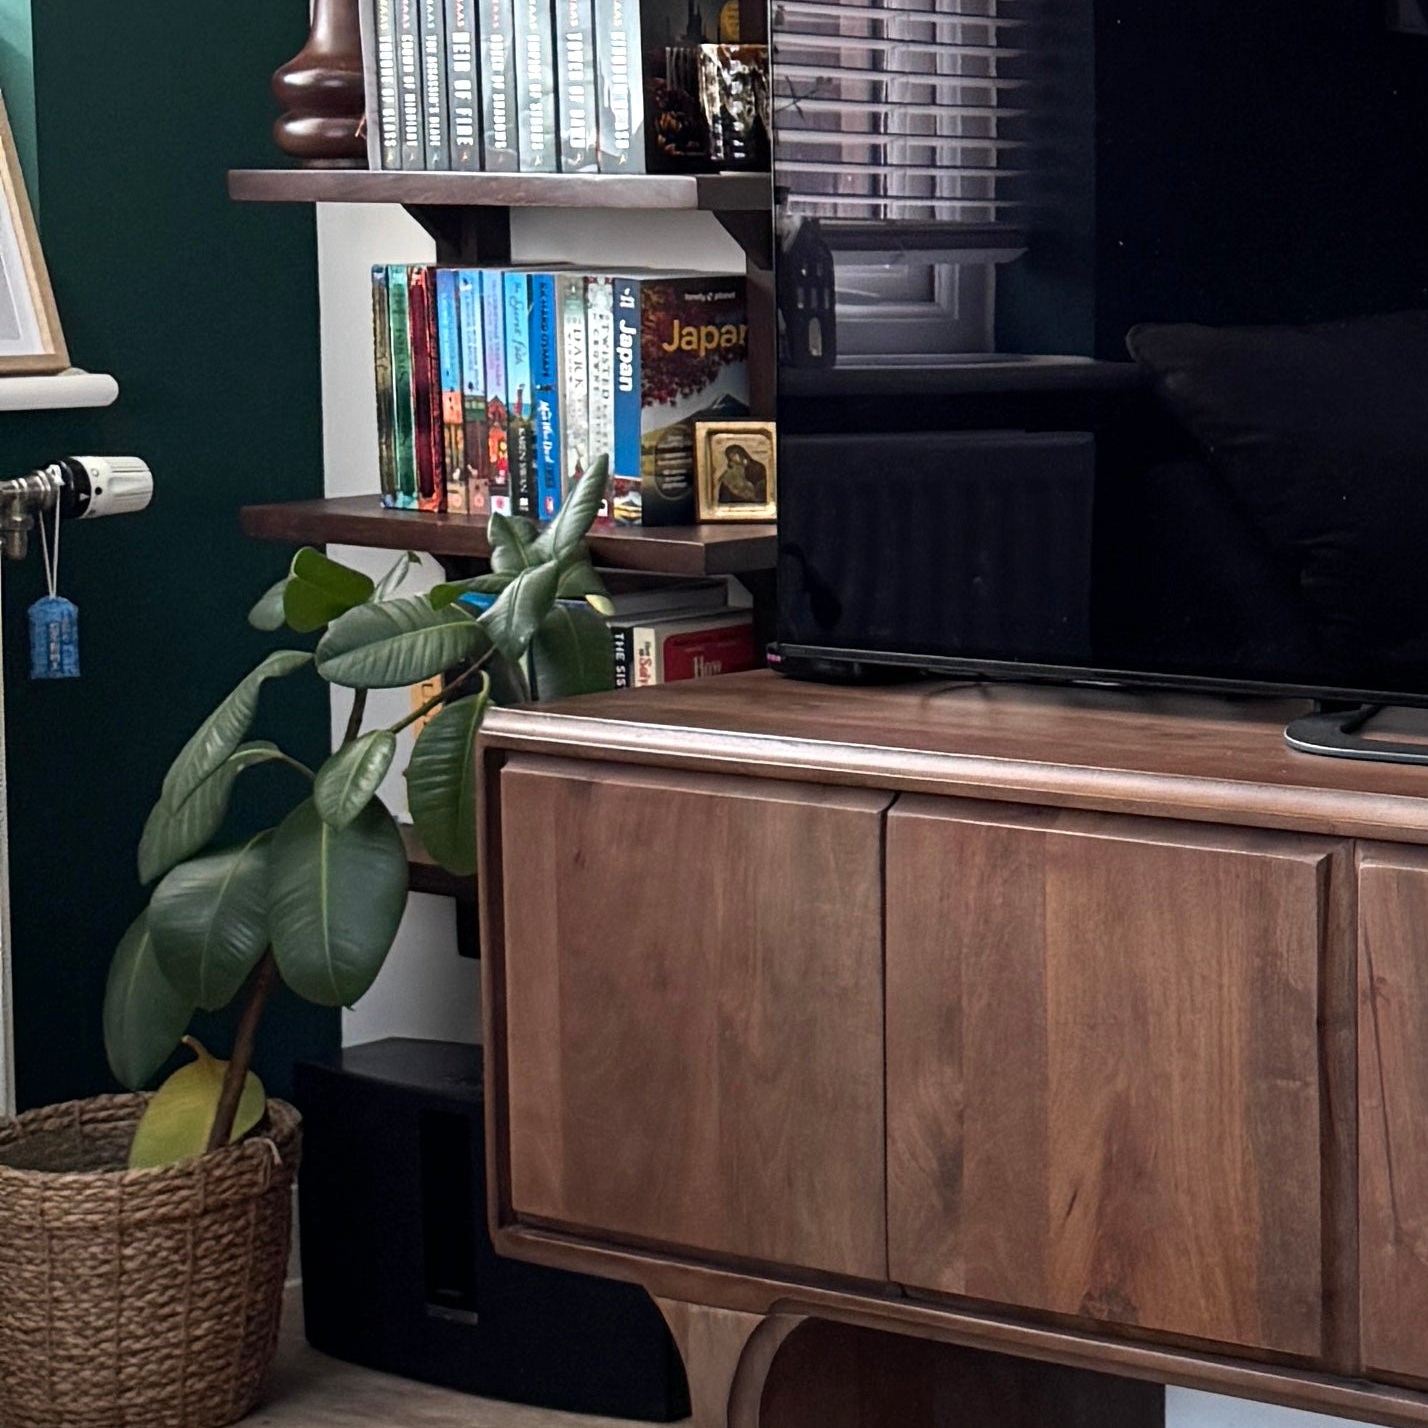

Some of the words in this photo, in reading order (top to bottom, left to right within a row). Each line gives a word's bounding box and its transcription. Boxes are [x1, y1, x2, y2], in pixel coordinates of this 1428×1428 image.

[451, 31, 471, 73] HEIR
[454, 79, 472, 100] OF
[568, 85, 585, 104] OF
[382, 108, 396, 147] GLASS
[456, 107, 474, 146] FIRE
[539, 281, 548, 332] RICHARD
[540, 333, 550, 378] OSMAN
[573, 328, 584, 389] DARK
[601, 324, 611, 400] TWISTED
[616, 318, 637, 392] Japan
[518, 427, 527, 461] KAREN
[519, 462, 528, 493] SWAN
[614, 632, 626, 661] THE
